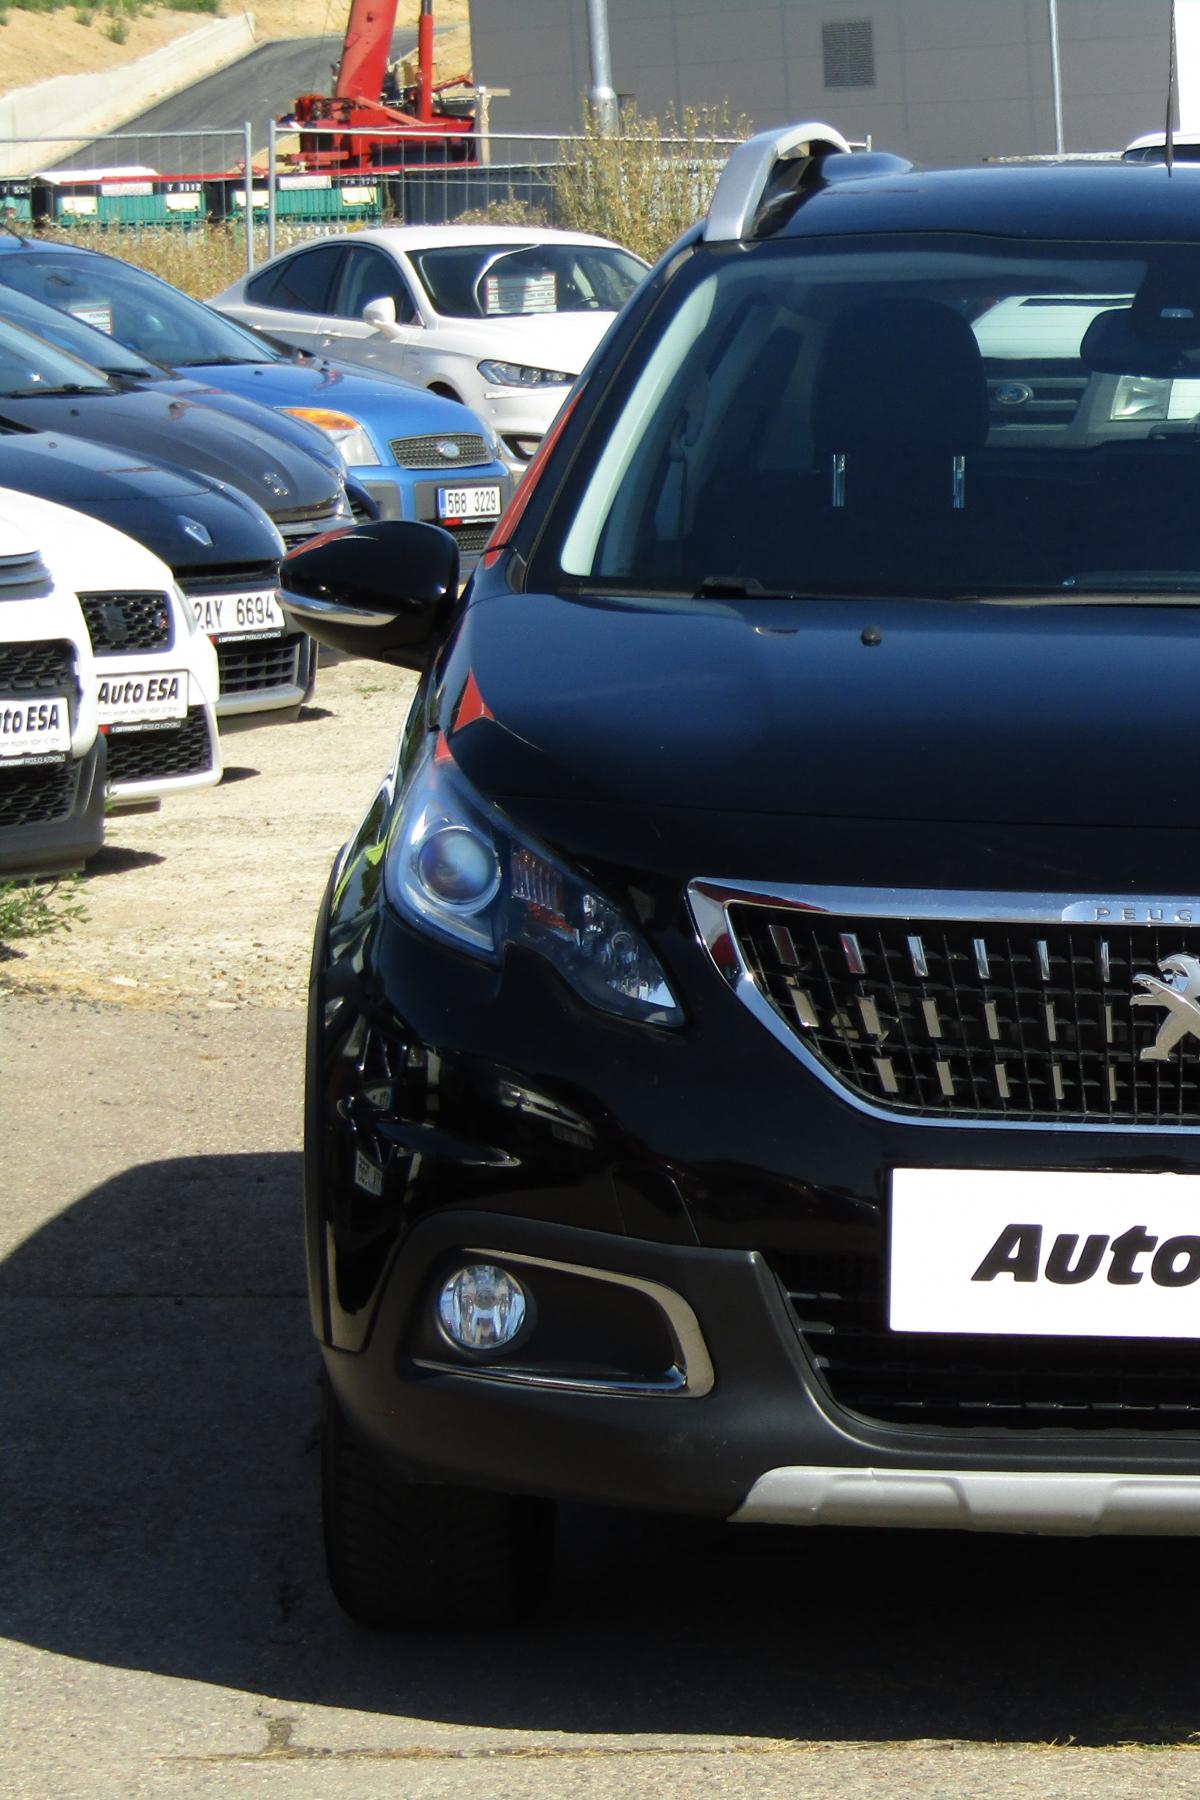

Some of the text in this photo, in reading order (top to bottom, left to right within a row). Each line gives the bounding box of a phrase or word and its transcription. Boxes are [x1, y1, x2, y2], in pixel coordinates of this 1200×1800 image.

[447, 490, 496, 514] 5B8 3229
[236, 595, 275, 626] 6694
[97, 677, 179, 705] Auto ESA
[26, 704, 60, 732] ESA
